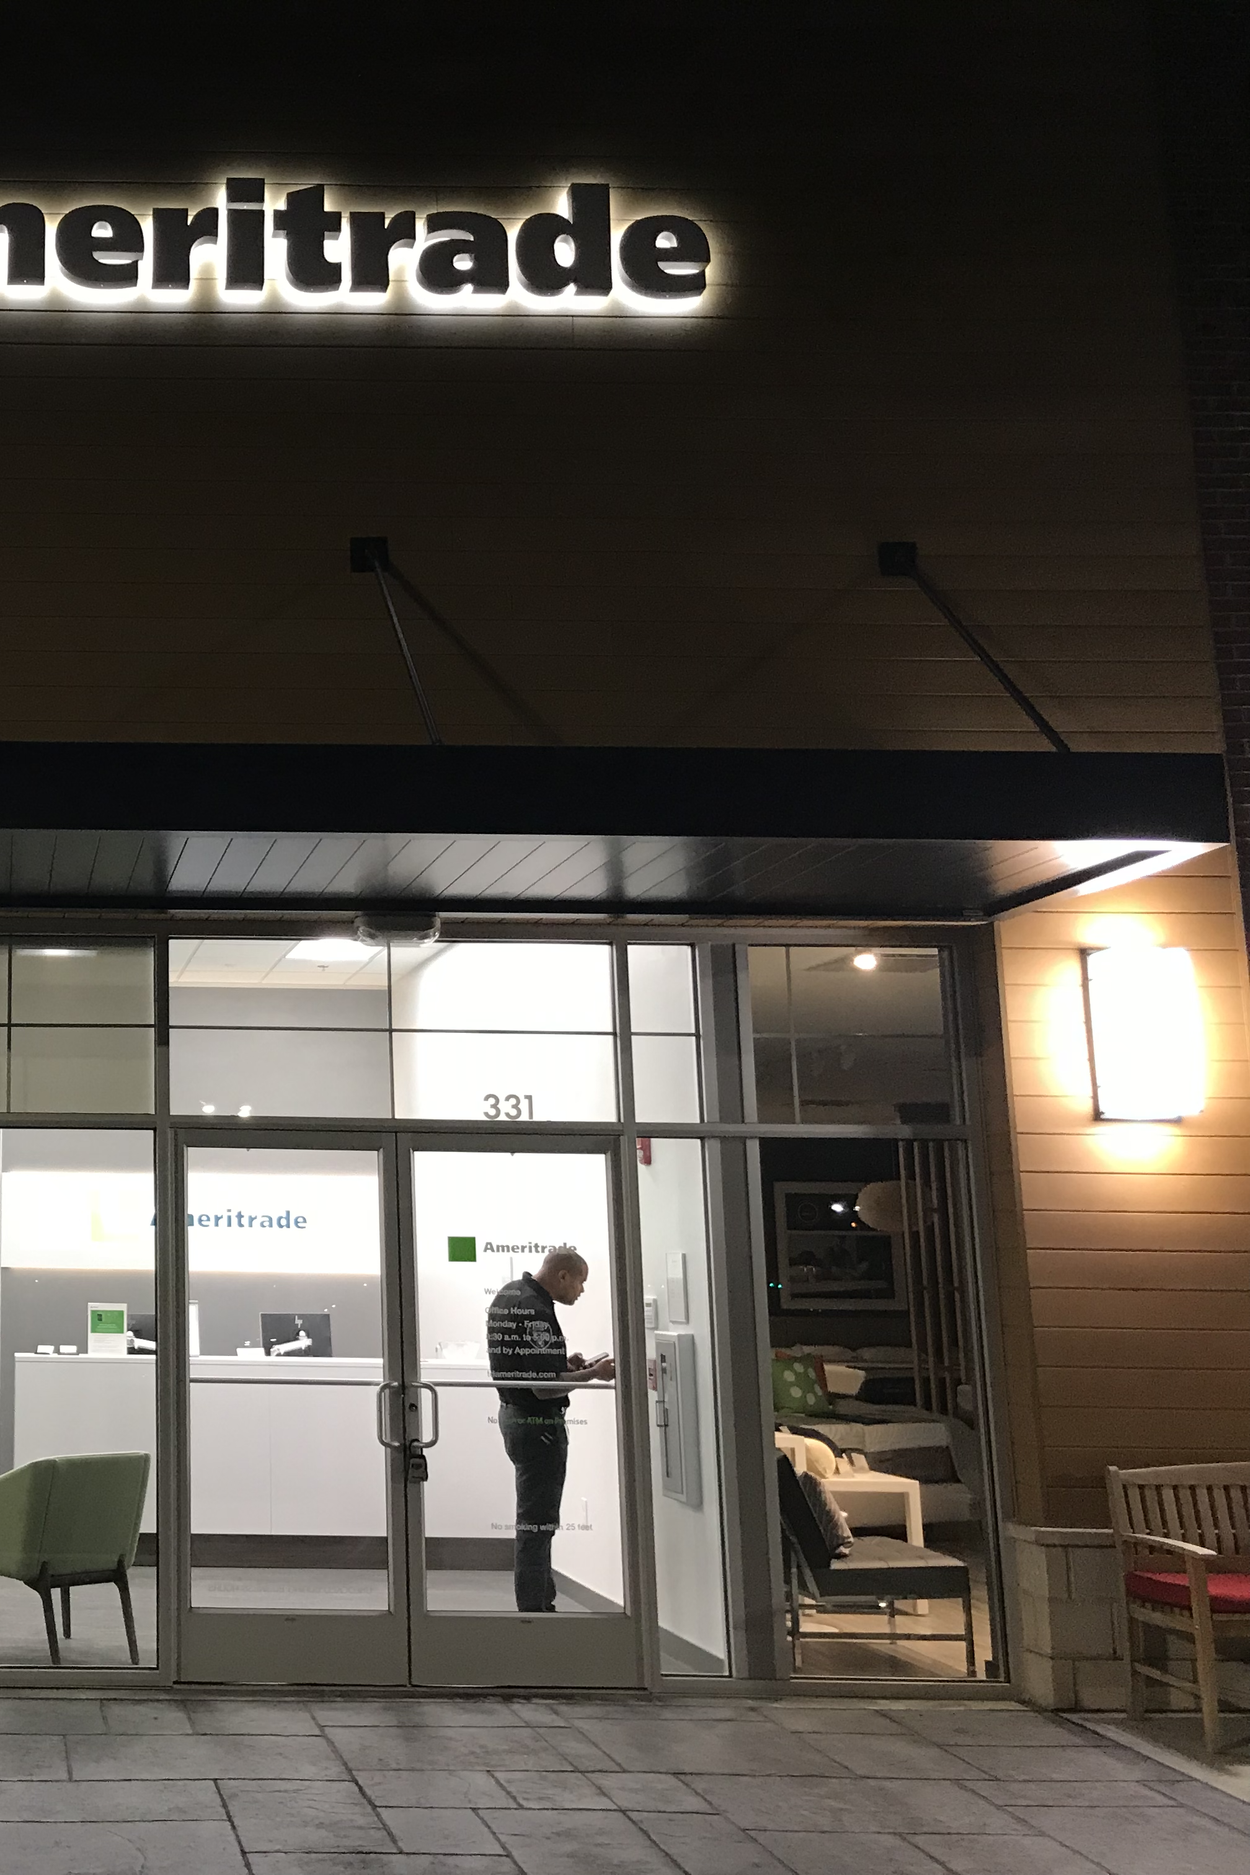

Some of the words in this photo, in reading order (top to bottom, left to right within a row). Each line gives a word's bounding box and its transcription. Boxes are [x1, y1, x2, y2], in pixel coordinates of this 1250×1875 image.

[483, 1093, 534, 1120] 331
[150, 1208, 308, 1229] eritrade
[510, 1307, 535, 1315] Hours
[503, 1346, 513, 1355] by
[514, 1346, 566, 1356] Appointment
[487, 1416, 498, 1424] No
[504, 1523, 538, 1533] smoking
[565, 1523, 576, 1531] 25
